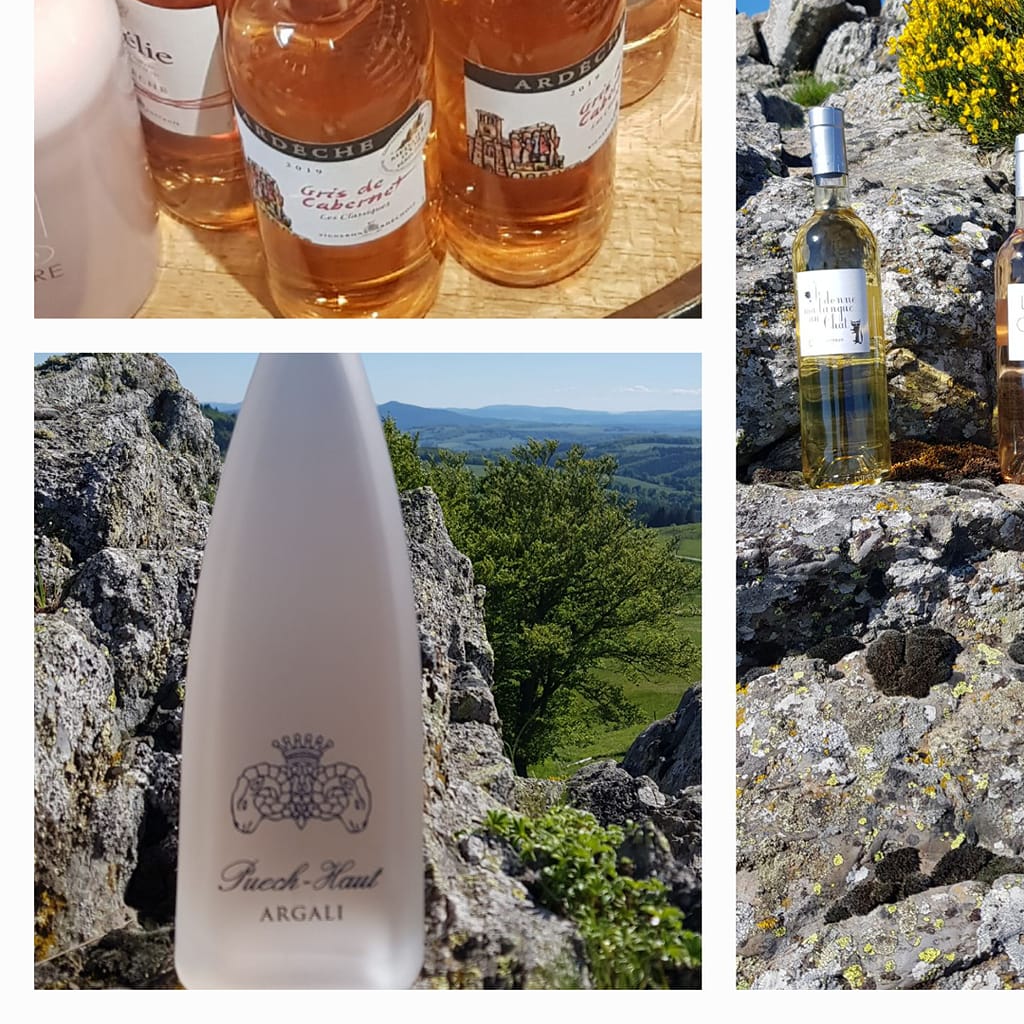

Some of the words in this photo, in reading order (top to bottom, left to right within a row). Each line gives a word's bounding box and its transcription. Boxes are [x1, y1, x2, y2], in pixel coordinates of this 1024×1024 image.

[300, 185, 348, 199] Gris
[357, 178, 384, 196] de
[302, 170, 411, 211] Cabernet
[218, 859, 383, 892] Puech-Haut
[260, 905, 343, 922] ARGALI
